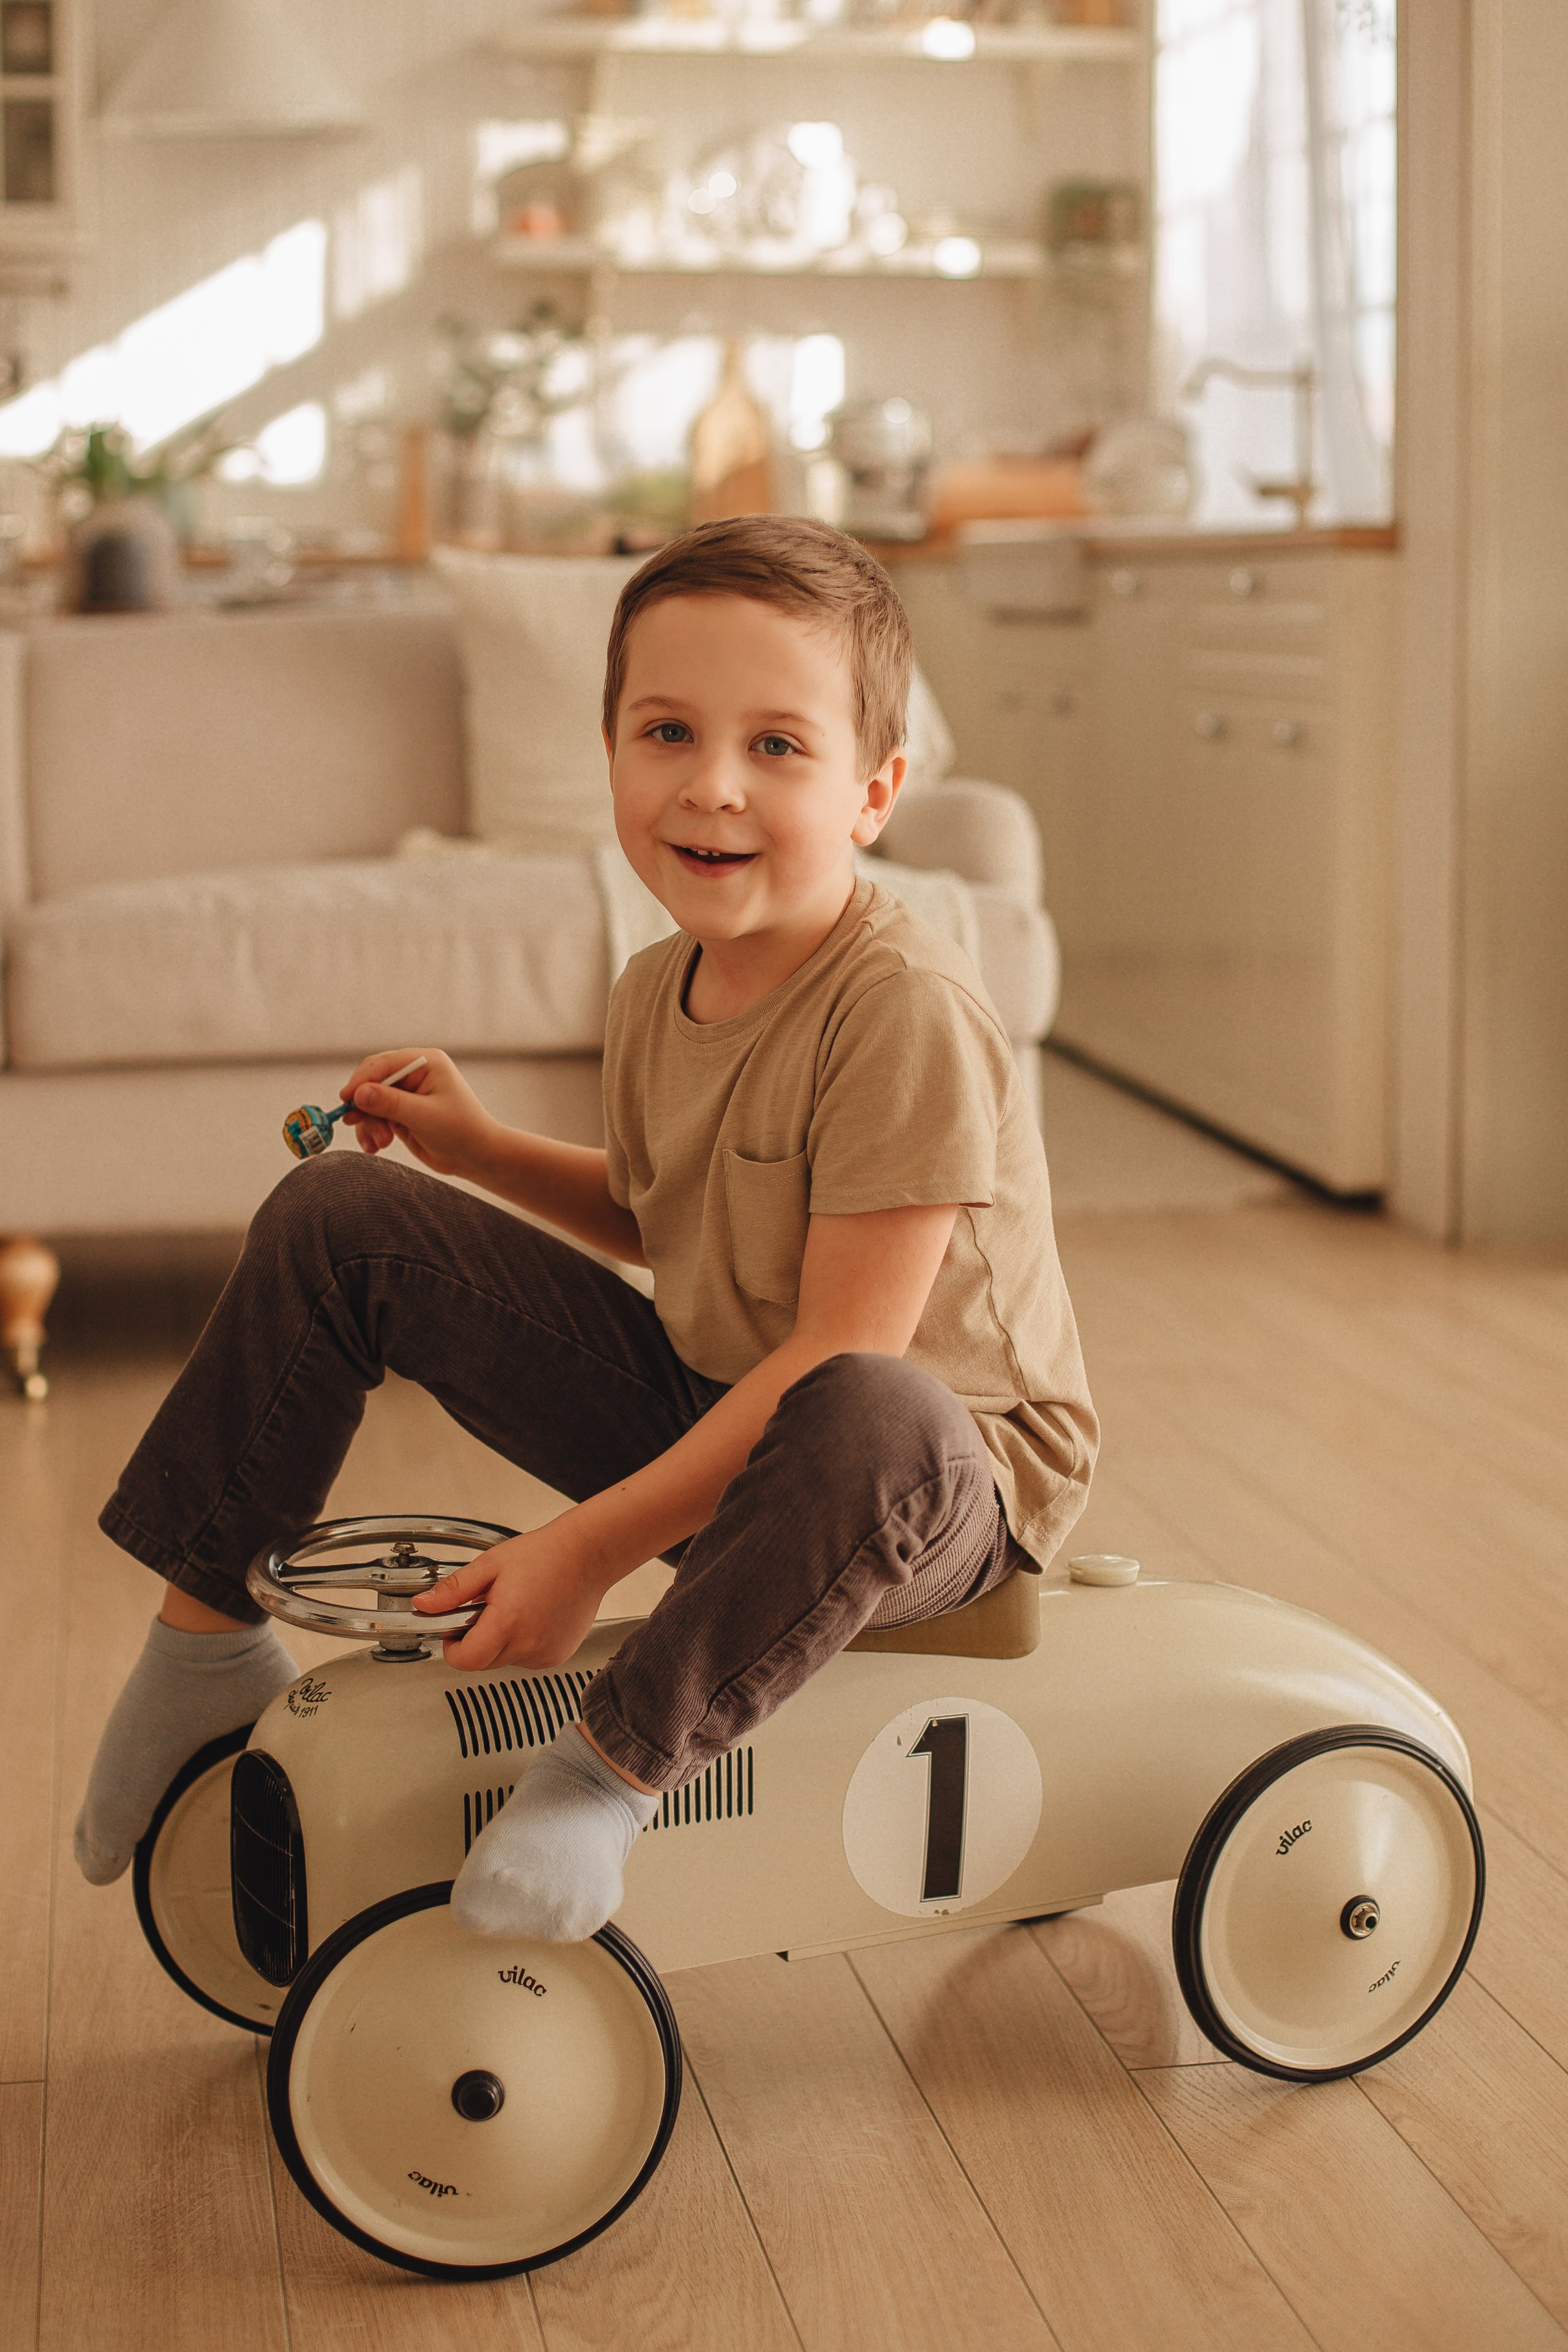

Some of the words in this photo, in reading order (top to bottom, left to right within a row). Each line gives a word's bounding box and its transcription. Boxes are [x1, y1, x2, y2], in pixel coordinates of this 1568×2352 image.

[298, 1705, 318, 1717] 1911
[906, 1713, 970, 1903] 1
[1275, 1819, 1313, 1855] vilac
[497, 1965, 548, 1997] vilac
[1368, 1960, 1401, 1993] vilac
[407, 2171, 459, 2198] vilac
